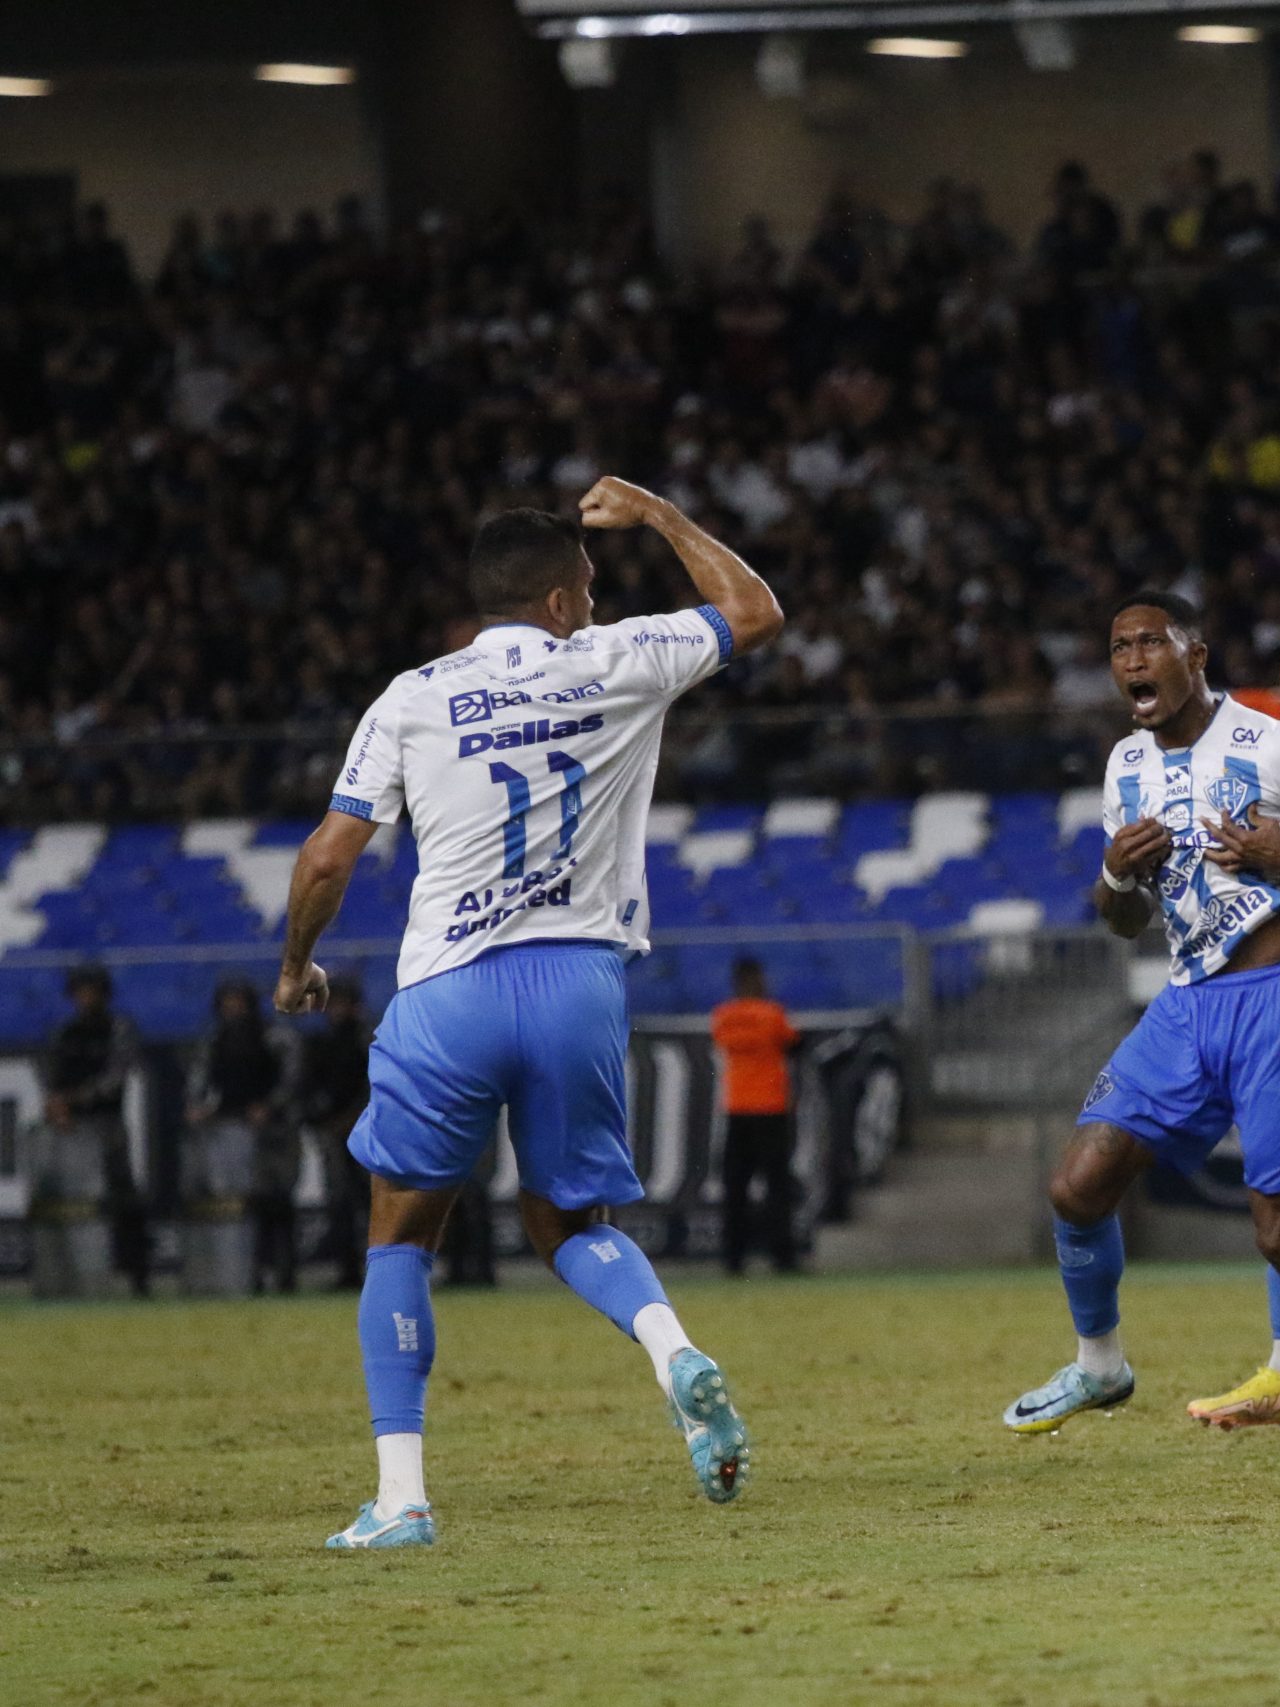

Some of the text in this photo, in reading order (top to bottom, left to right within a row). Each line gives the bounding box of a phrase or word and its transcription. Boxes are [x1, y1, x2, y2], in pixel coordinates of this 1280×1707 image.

[651, 633, 704, 646] Sankhya
[355, 717, 378, 768] Sankhya
[458, 713, 604, 758] Dallas
[489, 750, 587, 879] 11
